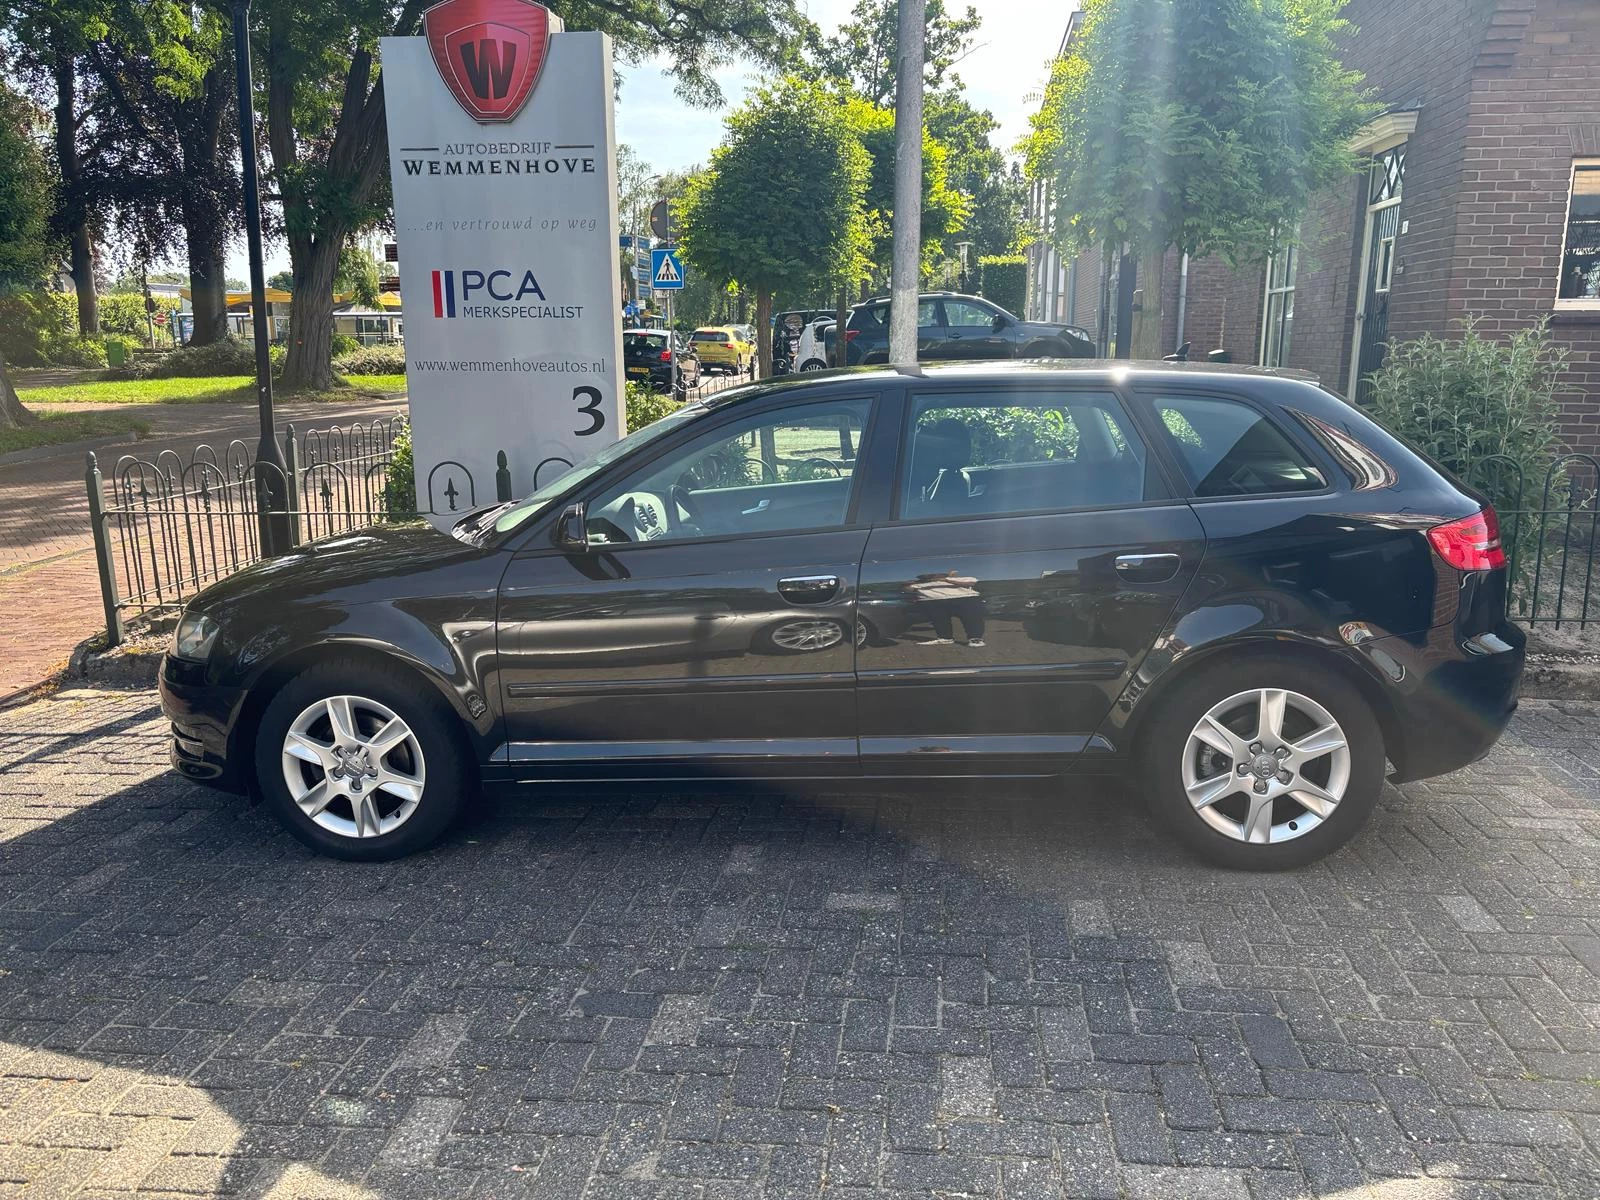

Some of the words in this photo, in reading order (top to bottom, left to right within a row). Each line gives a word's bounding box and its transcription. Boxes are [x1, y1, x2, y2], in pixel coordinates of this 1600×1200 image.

[460, 39, 517, 99] W
[443, 142, 552, 156] AUTOBEDRIJF
[401, 158, 595, 176] WEMMENHOVE
[453, 216, 532, 231] vertrouwd
[541, 218, 559, 233] op
[568, 217, 597, 231] weg
[462, 269, 546, 301] PCA
[463, 306, 583, 319] MERKSPECIALIST
[415, 358, 605, 373] www.wemmenhoveautos.nl
[572, 385, 605, 437] 3
